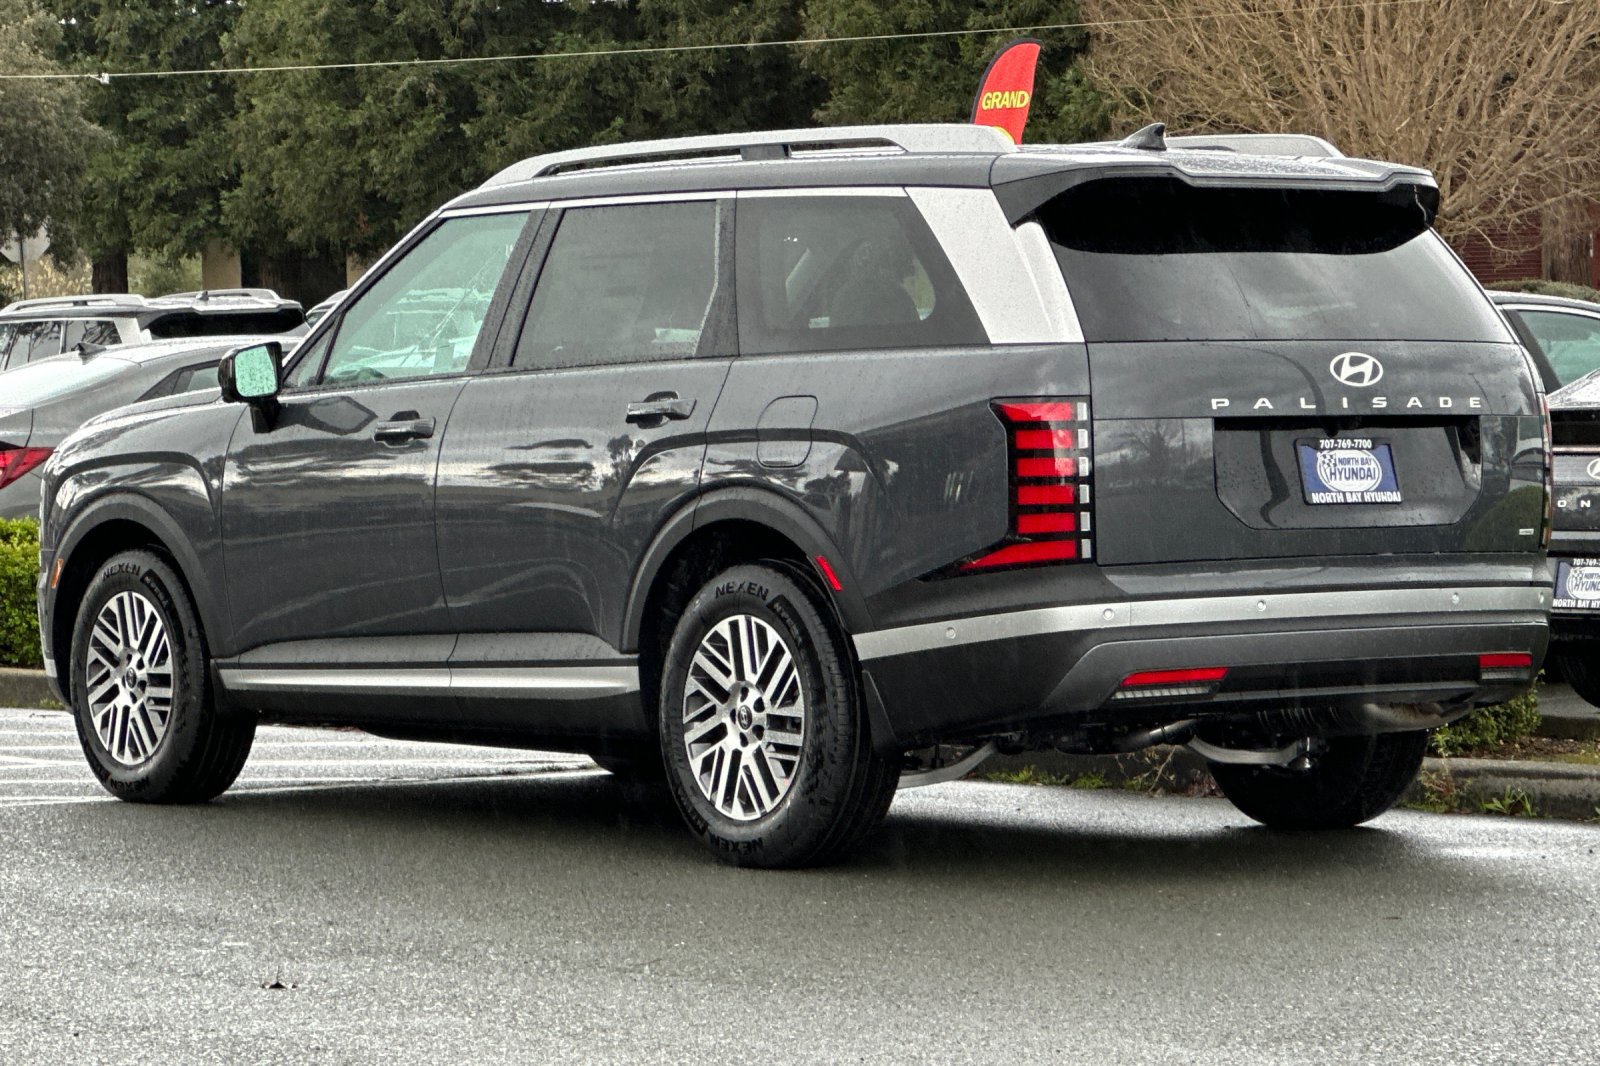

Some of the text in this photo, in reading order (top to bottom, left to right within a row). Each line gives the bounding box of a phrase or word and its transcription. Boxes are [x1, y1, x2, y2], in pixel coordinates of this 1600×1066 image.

[981, 90, 1030, 111] GRAND
[1211, 396, 1482, 410] PALISADE
[1319, 439, 1372, 449] 707-769-7700
[1338, 457, 1372, 466] NORTH BAY
[1329, 467, 1376, 481] HYUNDAI
[1311, 491, 1401, 503] NORTH BAY HYUNDAI
[103, 562, 141, 581] NEXEN
[715, 581, 769, 601] NEXEN
[1552, 598, 1576, 607] NORTH
[1577, 599, 1590, 608] BAY
